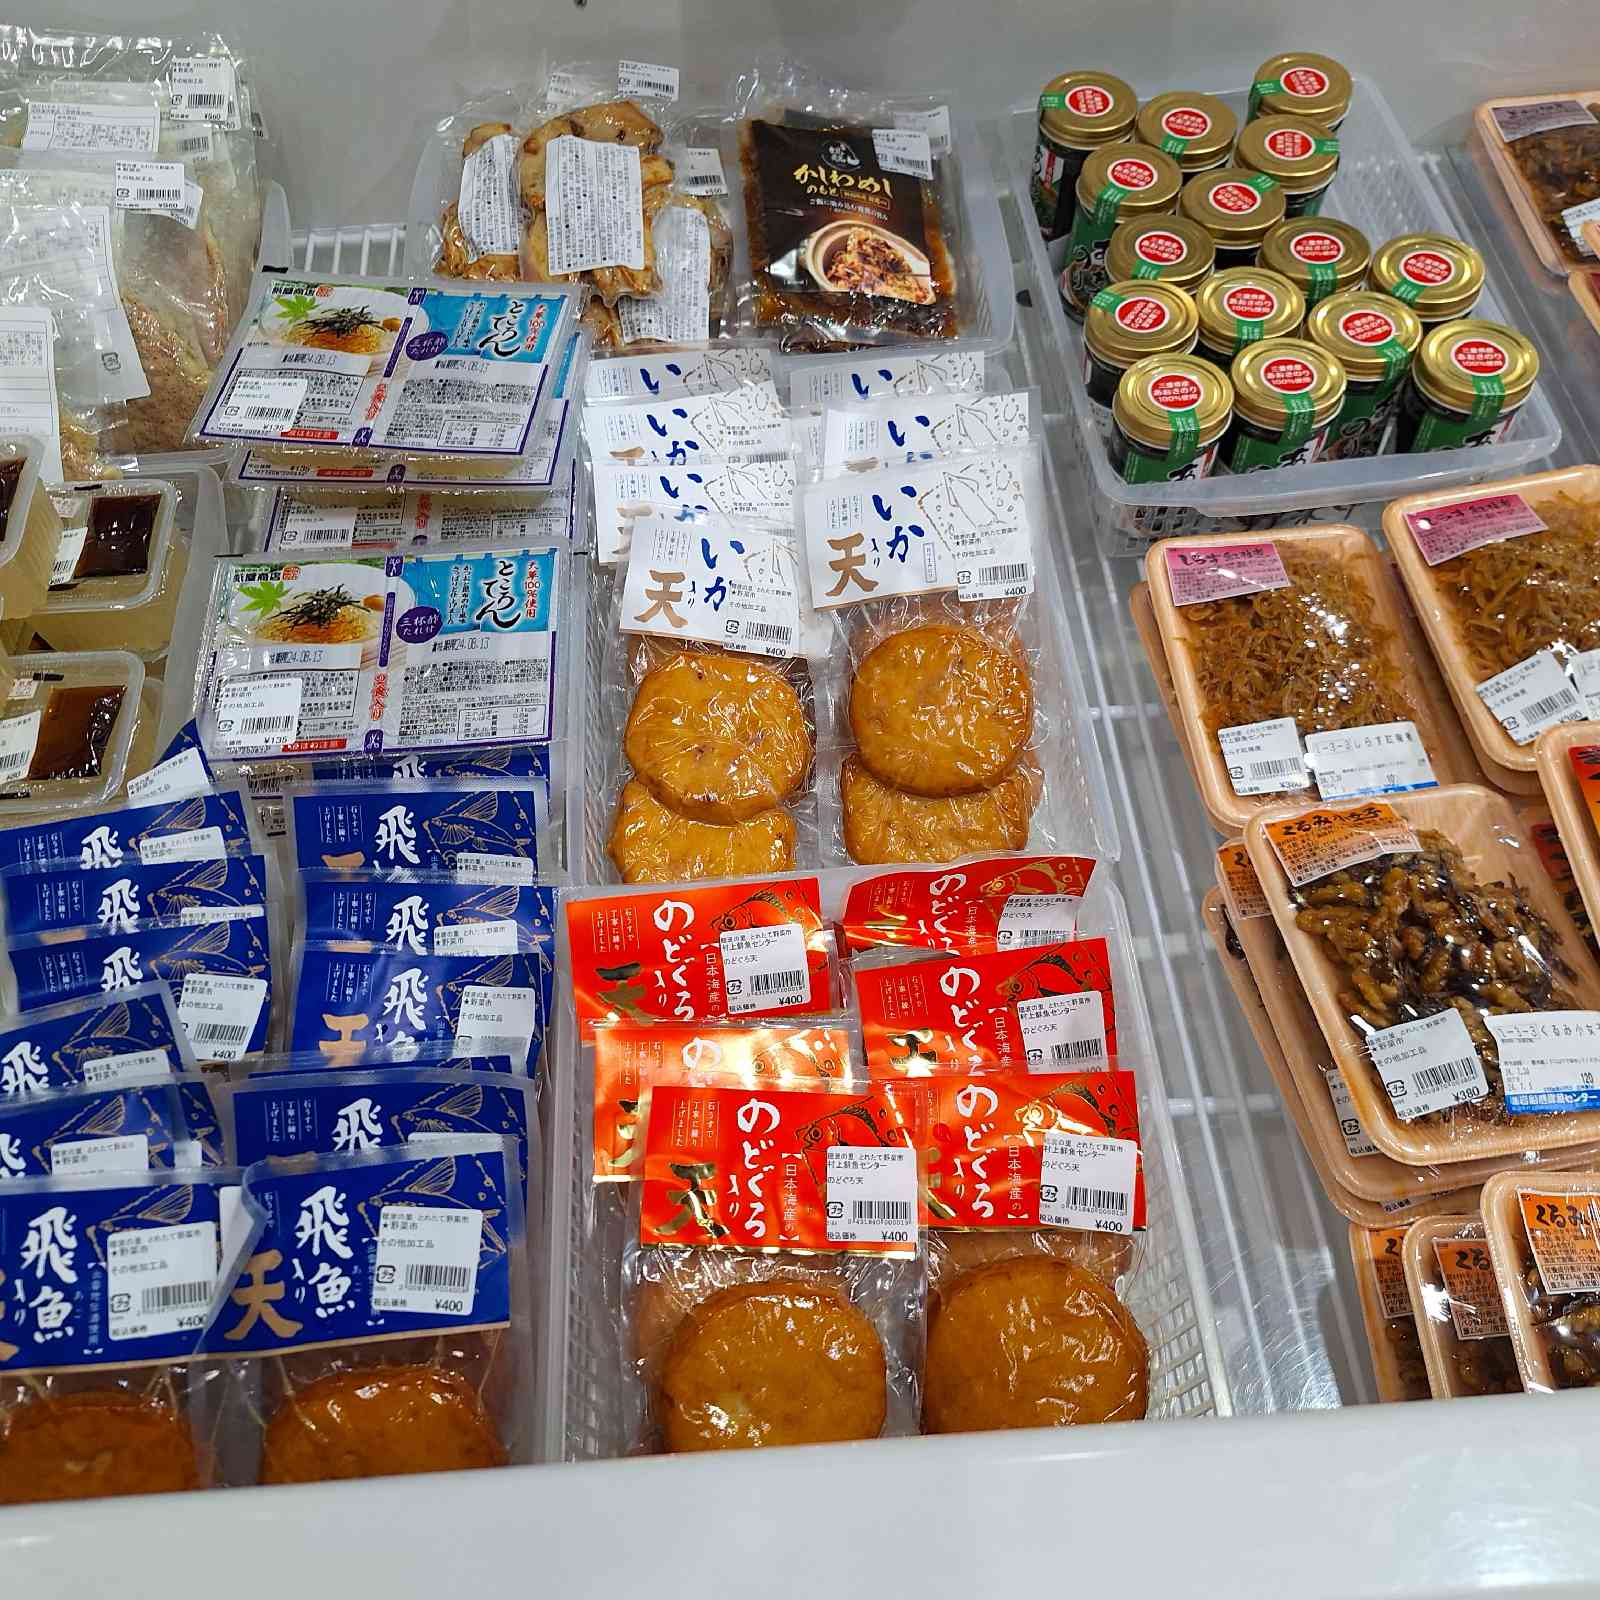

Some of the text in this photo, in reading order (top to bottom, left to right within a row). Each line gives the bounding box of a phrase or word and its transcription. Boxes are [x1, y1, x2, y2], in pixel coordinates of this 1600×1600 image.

[793, 164, 892, 198] かしわめし
[806, 184, 838, 197] のもと
[1229, 298, 1272, 306] あおさのり
[1236, 292, 1264, 300] 三重県産
[479, 300, 523, 357] ところてん
[1458, 352, 1502, 360] あおさのり
[640, 364, 681, 394] い
[852, 369, 893, 400] い
[1266, 368, 1310, 380] あおさのり
[1154, 387, 1197, 396] あおさのり
[1158, 394, 1198, 403] 100%使用
[872, 485, 925, 562] いか
[825, 532, 879, 597] 天
[871, 538, 880, 568] 入り
[701, 538, 745, 611] いか
[476, 560, 521, 628] ところてん
[634, 570, 688, 628] 天
[688, 580, 696, 608] 入り
[1004, 586, 1026, 596] ¥400
[766, 646, 786, 657] ¥400
[375, 805, 420, 864] 飛
[1282, 807, 1382, 836] くるみ小女子
[80, 826, 124, 870] 飛
[97, 879, 140, 935] 飛
[930, 873, 968, 956] のどぐろ
[386, 895, 429, 955] 飛
[722, 938, 778, 952] 村上鮮魚センター
[101, 947, 143, 992] 飛
[653, 899, 695, 1021] のどぐろ
[724, 954, 758, 965] のどぐろ天
[654, 970, 667, 1008] 入り
[727, 980, 742, 996] プラ
[778, 994, 803, 1006] ¥400
[1020, 1008, 1077, 1020] 村上鮮魚センター
[1048, 998, 1091, 1010] とれたて野菜市
[940, 966, 984, 1076] のどぐろ
[1023, 1024, 1058, 1034] のどぐろ天
[2, 1041, 49, 1095] 飛
[213, 1050, 236, 1060] ¥400
[1453, 1086, 1480, 1102] ¥380
[272, 1102, 280, 1142] 上げました
[332, 1098, 384, 1154] 飛
[676, 1101, 684, 1148] 上げました
[706, 1101, 716, 1139] 石うすで
[857, 1153, 904, 1162] とれたて野菜市
[956, 1084, 999, 1218] のどぐろ
[1043, 1145, 1106, 1158] 村上鮮魚センター
[1076, 1142, 1124, 1153] とれたて野菜市
[737, 1097, 781, 1238] のどぐろ
[828, 1161, 888, 1170] 村上鮮魚センター
[953, 1158, 966, 1200] 入り
[1002, 1134, 1029, 1220] 【日本海産の】
[1042, 1159, 1080, 1172] のどぐろ天
[828, 1176, 864, 1185] のどぐろ天
[1040, 1185, 1058, 1202] プラ
[728, 1174, 740, 1217] 入り
[780, 1152, 801, 1241] 【日本海産の】
[418, 1214, 469, 1224] とれたて野菜市
[827, 1201, 844, 1219] プラ
[1040, 1214, 1124, 1232] 税込価格 ¥400
[1536, 1204, 1590, 1228] くるみ
[380, 1238, 434, 1249] その他加工品
[828, 1231, 908, 1242] 税込価格 ¥400
[296, 1186, 354, 1319] 飛魚
[20, 1206, 78, 1344] 飛魚
[110, 1260, 168, 1274] その他加工品
[293, 1258, 306, 1304] 入り
[377, 1265, 396, 1284] プラ
[14, 1279, 26, 1326] 入り
[224, 1250, 303, 1340] 天
[435, 1299, 464, 1312] ¥400
[176, 1314, 208, 1328] ¥400
